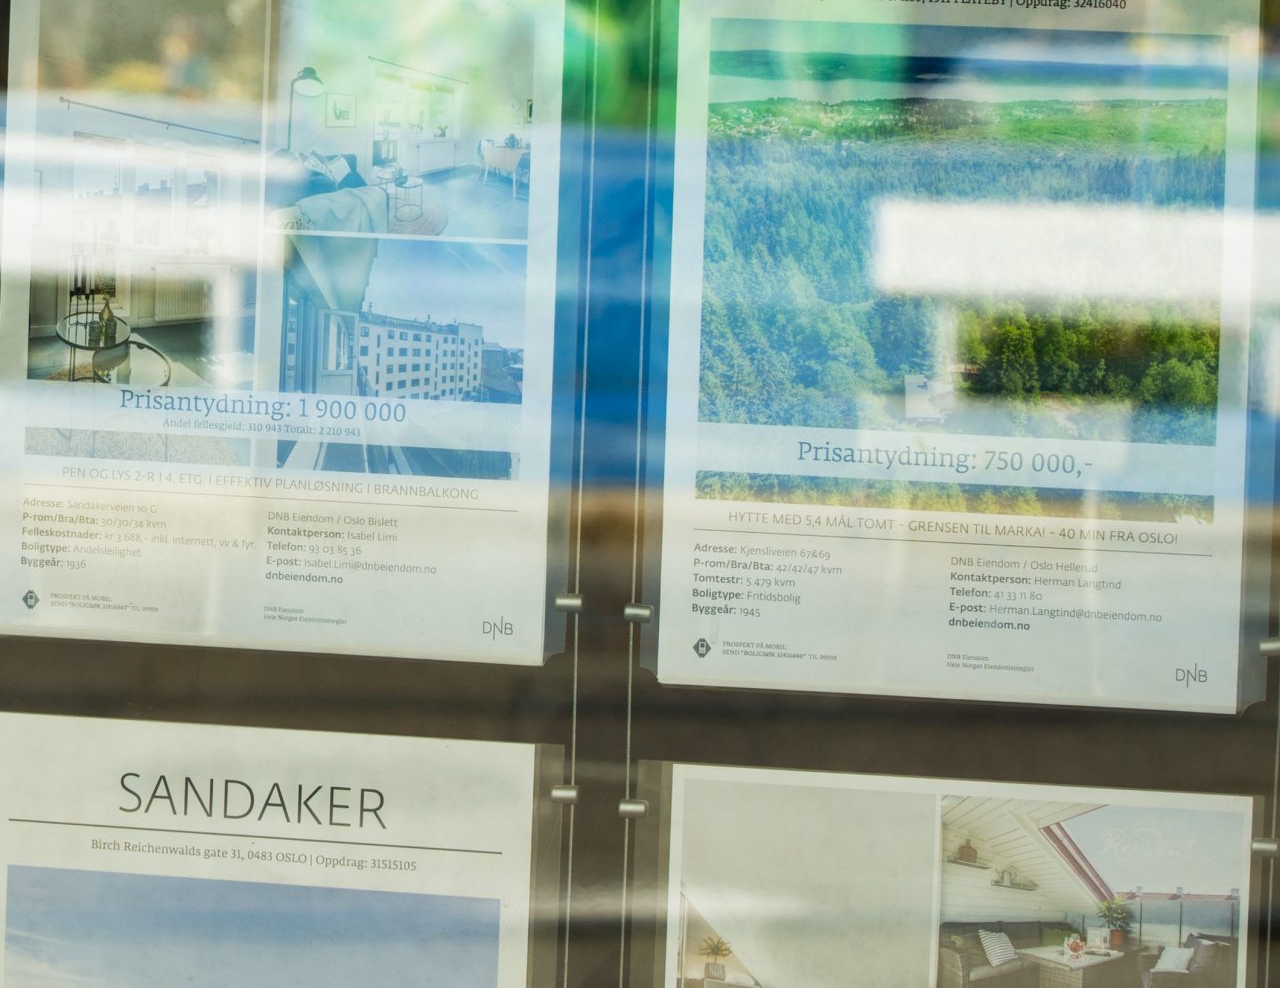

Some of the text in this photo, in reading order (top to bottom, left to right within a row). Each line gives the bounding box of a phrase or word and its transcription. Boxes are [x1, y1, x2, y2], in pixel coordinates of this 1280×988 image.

[119, 388, 406, 422] Prisantydning: 1 900 000
[797, 441, 1092, 478] Prisantydning: 750 000,-
[728, 511, 768, 524] HYTTE
[772, 513, 802, 525] MED
[805, 514, 821, 528] 5,4
[825, 514, 853, 528] MÅL
[856, 517, 895, 530] TOMT
[908, 520, 968, 534] GRENSEN
[972, 523, 991, 535] TIL
[994, 524, 1045, 538] MARKA!
[1058, 527, 1075, 539] 40
[1079, 528, 1105, 541] MIN
[1109, 530, 1135, 542] FRA
[1138, 531, 1178, 544] OSLO!
[265, 570, 343, 584] dnbeiendom.no
[692, 587, 801, 605] Boligtype: Fritidsbolig
[482, 615, 513, 640] DNB
[948, 616, 1030, 630] dnbeiendom.no
[1175, 662, 1208, 688] DNB
[119, 772, 386, 829] SANDAKER
[91, 839, 120, 850] Birch
[123, 841, 201, 856] Reichenwalds
[203, 848, 227, 858] gate
[230, 848, 244, 860] 31,
[247, 850, 272, 861] 0483
[275, 852, 307, 864] OSLO
[315, 855, 367, 869] Oppdrag:
[370, 858, 416, 871] 31515105
